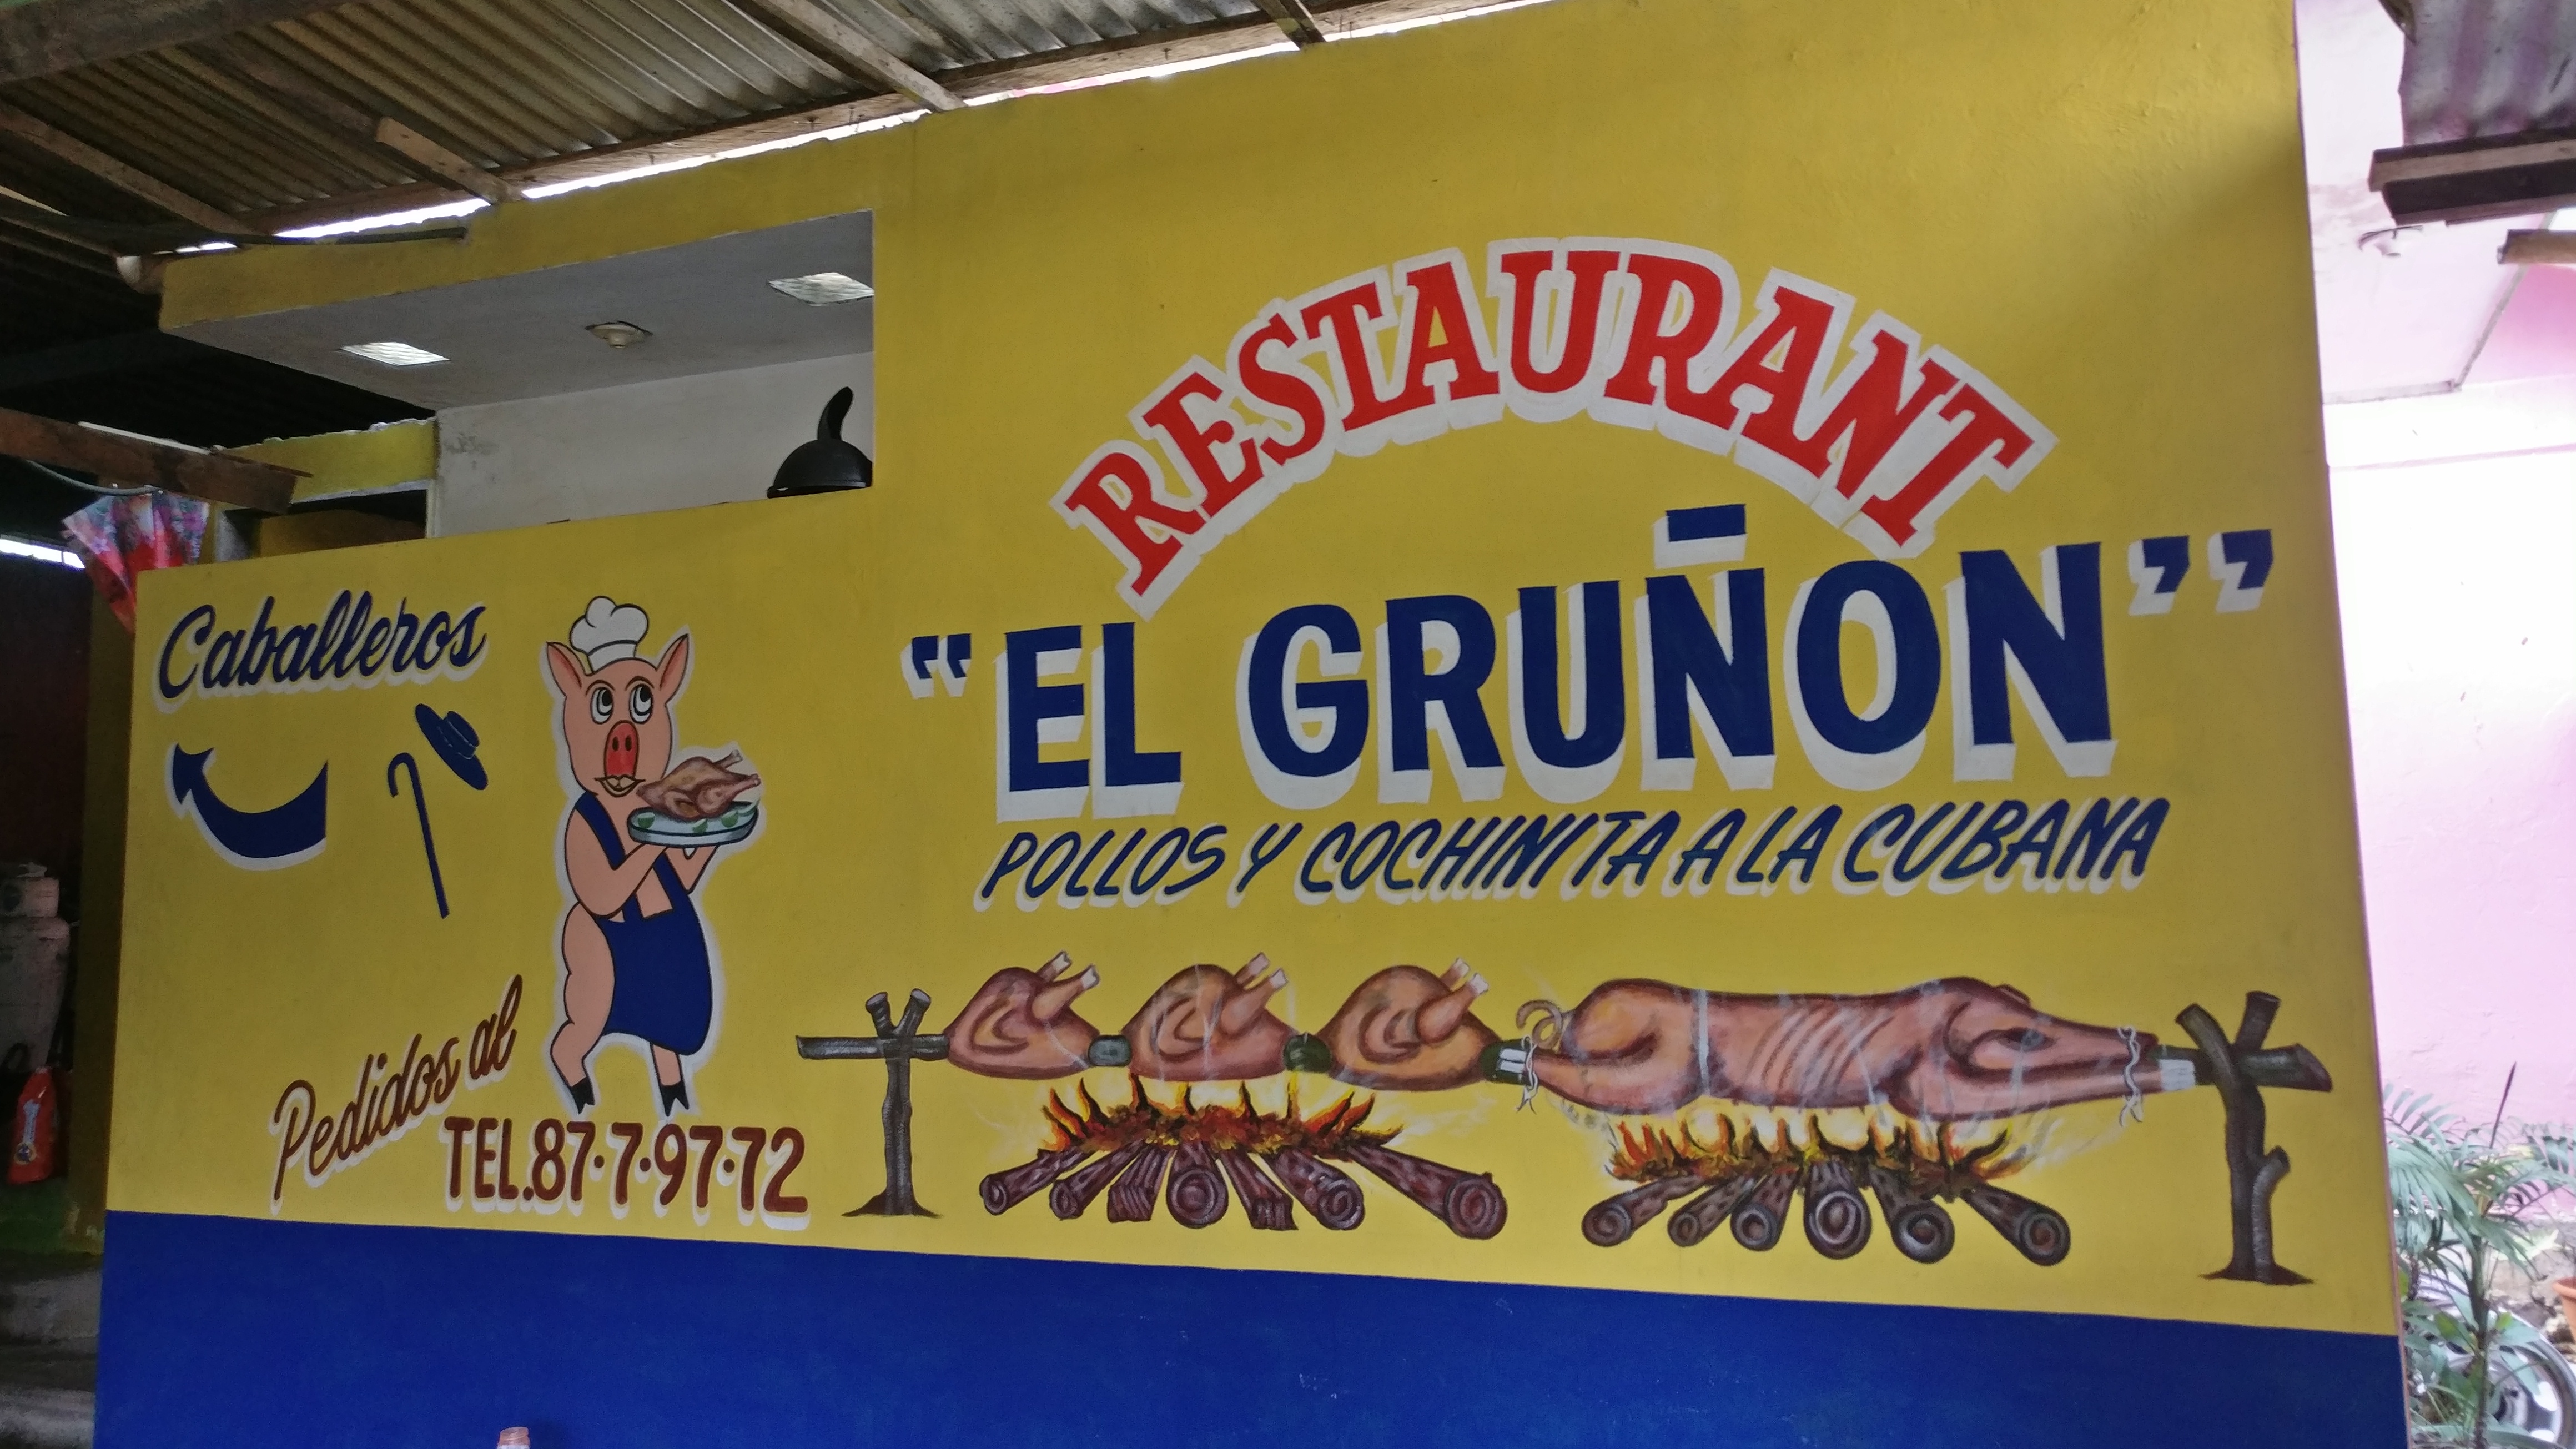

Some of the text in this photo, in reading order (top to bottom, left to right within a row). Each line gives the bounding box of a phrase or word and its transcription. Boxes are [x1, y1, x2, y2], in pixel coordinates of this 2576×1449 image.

[1065, 250, 2034, 595] RESTAURANT
[158, 590, 487, 698] Caballeros
[982, 797, 2171, 898] POLLOS Y COCHINITA A LA CUBANA
[274, 974, 524, 1201] Pedidos al
